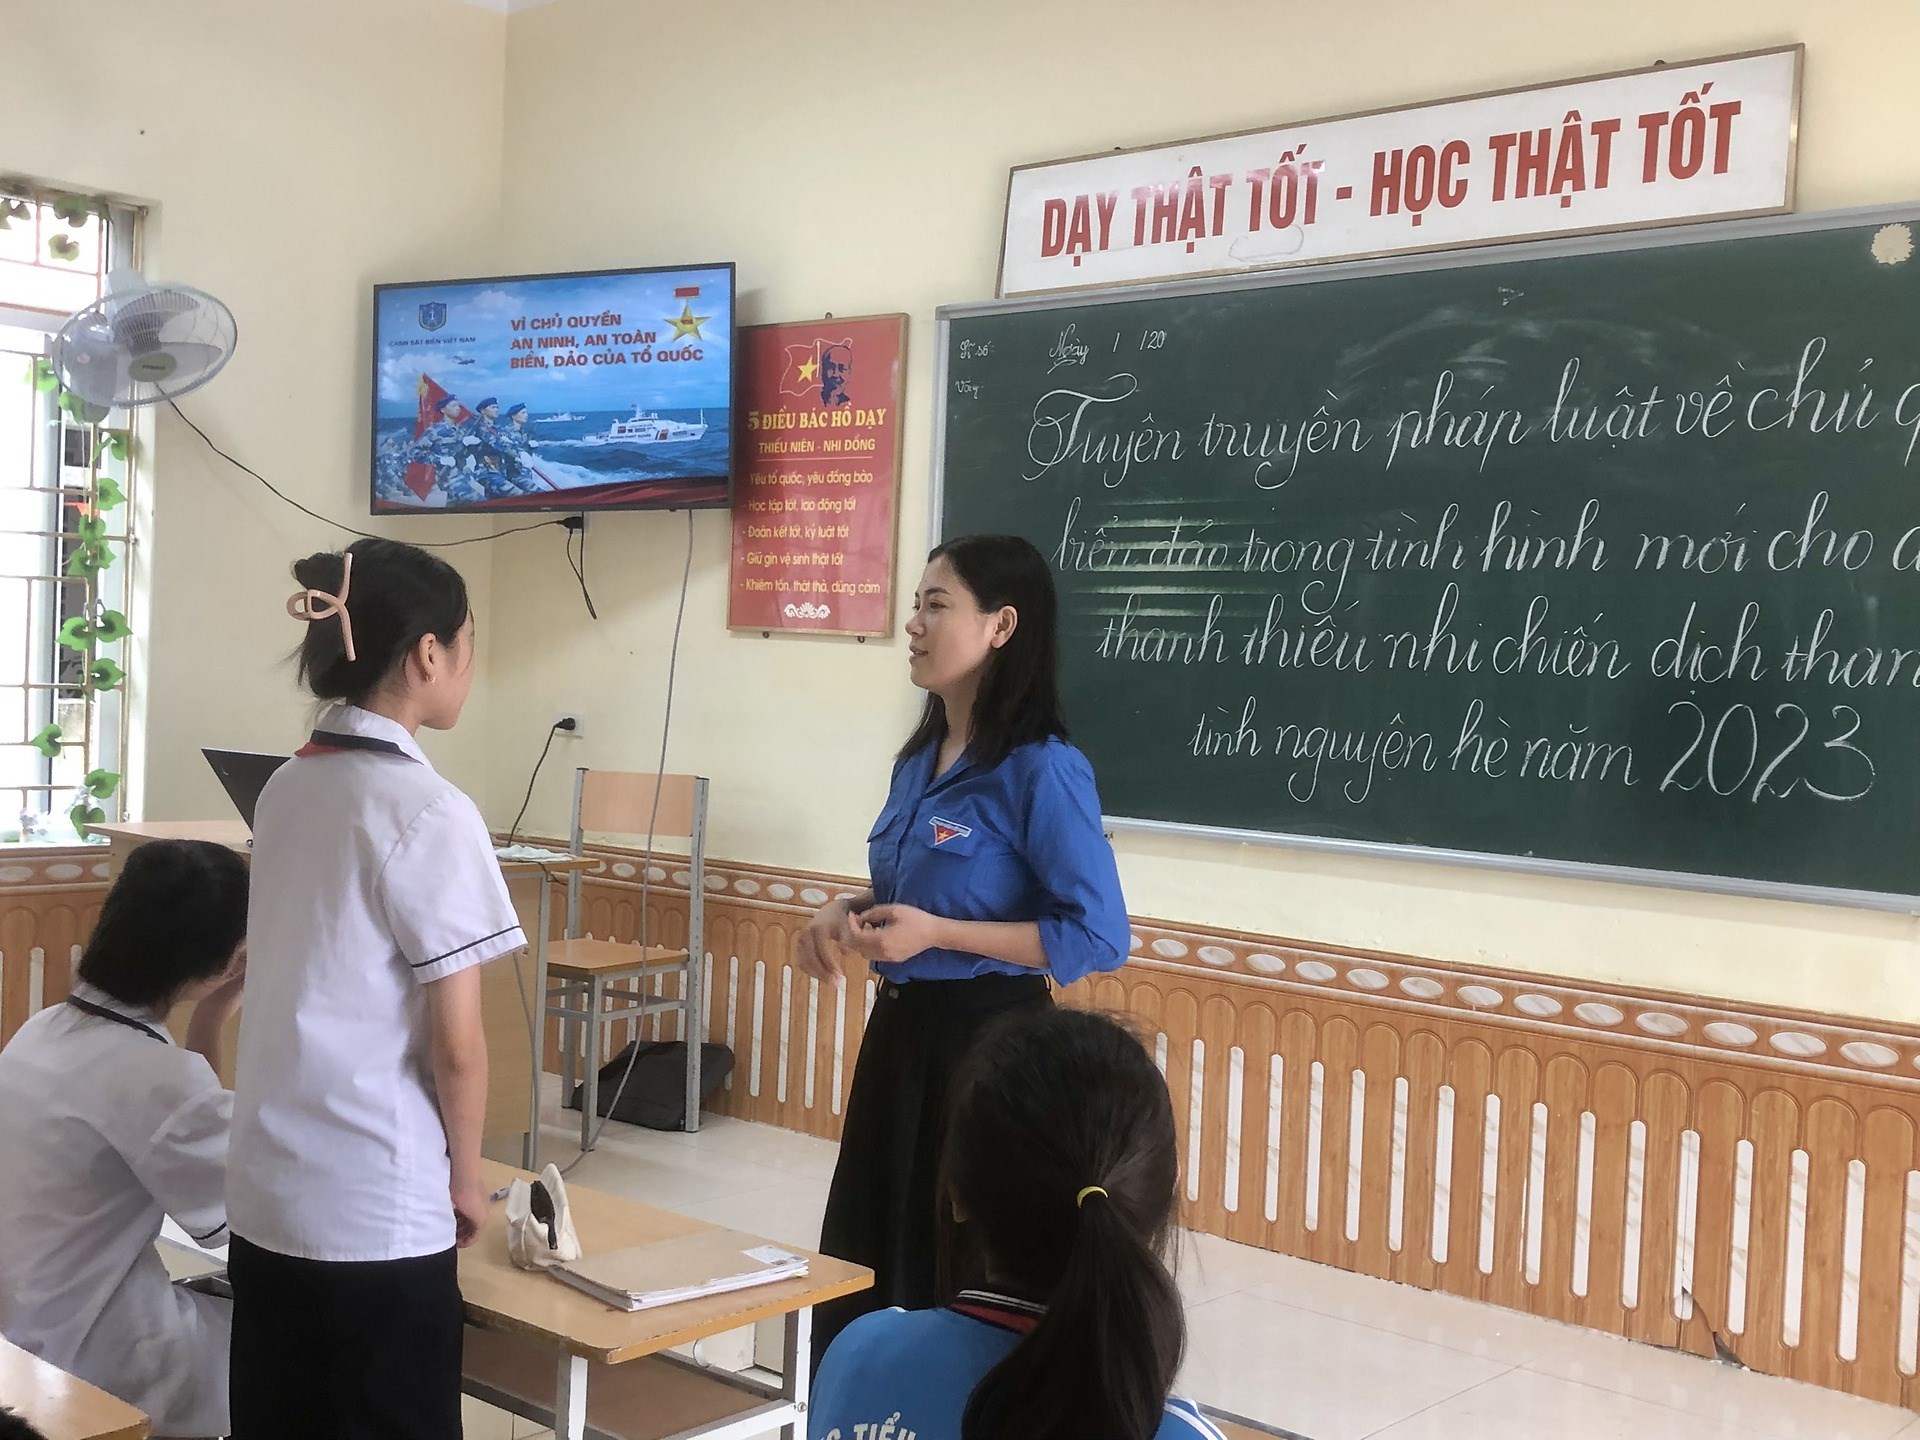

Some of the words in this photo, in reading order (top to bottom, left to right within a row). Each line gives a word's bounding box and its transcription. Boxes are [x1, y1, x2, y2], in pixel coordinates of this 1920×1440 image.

[1041, 190, 1120, 267] DẠY
[1131, 165, 1233, 254] THẬT
[1246, 143, 1326, 233] TỐT
[1369, 139, 1471, 227] HỌC
[1488, 109, 1621, 209] THẬT
[1638, 81, 1742, 184] TỐT
[510, 316, 526, 331] VÌ
[530, 313, 562, 330] CHỦ
[510, 338, 533, 350] AN
[537, 335, 579, 349] NINH,
[584, 334, 607, 346] AN
[611, 329, 657, 345] TOÀN
[1047, 323, 1090, 374] Ngày
[510, 351, 549, 369] BIỂN,
[553, 350, 588, 367] ĐẢO
[592, 348, 627, 366] CỦA
[631, 345, 653, 363] TỔ
[656, 344, 704, 362] QUỐC
[762, 405, 796, 430] ĐIỀU
[799, 407, 829, 429] BÁC
[831, 401, 852, 428] HỒ
[855, 408, 887, 430] DẠY
[1022, 372, 1188, 488] Tuyên
[1197, 389, 1374, 490] truyền
[1386, 369, 1532, 473] pháp
[1543, 357, 1665, 449] luật
[1675, 360, 1745, 439] về
[1747, 336, 1881, 434] chủ
[758, 437, 787, 454] THIẾU
[790, 438, 815, 453] NIÊN
[823, 440, 841, 452] NHI
[844, 434, 876, 451] ĐỒNG
[807, 471, 824, 486] yêu
[826, 469, 851, 487] đồng
[854, 469, 873, 484] bào
[748, 499, 766, 513] Học
[818, 498, 842, 514] động
[748, 524, 772, 538] Đoàn
[773, 525, 787, 538] kết
[837, 525, 849, 538] tốt
[747, 551, 762, 565] Giữ
[764, 551, 778, 567] gìn
[780, 552, 791, 568] vệ
[792, 553, 809, 565] sinh
[812, 553, 830, 568] thật
[831, 551, 844, 566] tốt
[1050, 496, 1139, 572] biển
[1149, 516, 1229, 571] đảo
[1238, 528, 1355, 615] trong
[1365, 503, 1467, 571] tình
[1479, 498, 1609, 573] hình
[1635, 502, 1757, 574] mới
[1767, 490, 1875, 572] cho
[745, 578, 773, 592] Khiêm
[793, 580, 811, 594] thật
[832, 581, 856, 596] dũng
[858, 579, 880, 594] cảm
[1095, 593, 1231, 665] thanh
[1240, 593, 1374, 673] thiếu
[1383, 582, 1483, 675] nhi
[1493, 595, 1632, 679] chiến
[1651, 601, 1770, 696] dịch
[1781, 608, 1920, 689] than
[1188, 695, 1262, 759] tình
[1274, 713, 1440, 804] nguyện
[1448, 698, 1512, 779] hè
[1519, 723, 1640, 787] năm
[1659, 701, 1876, 804] 2023
